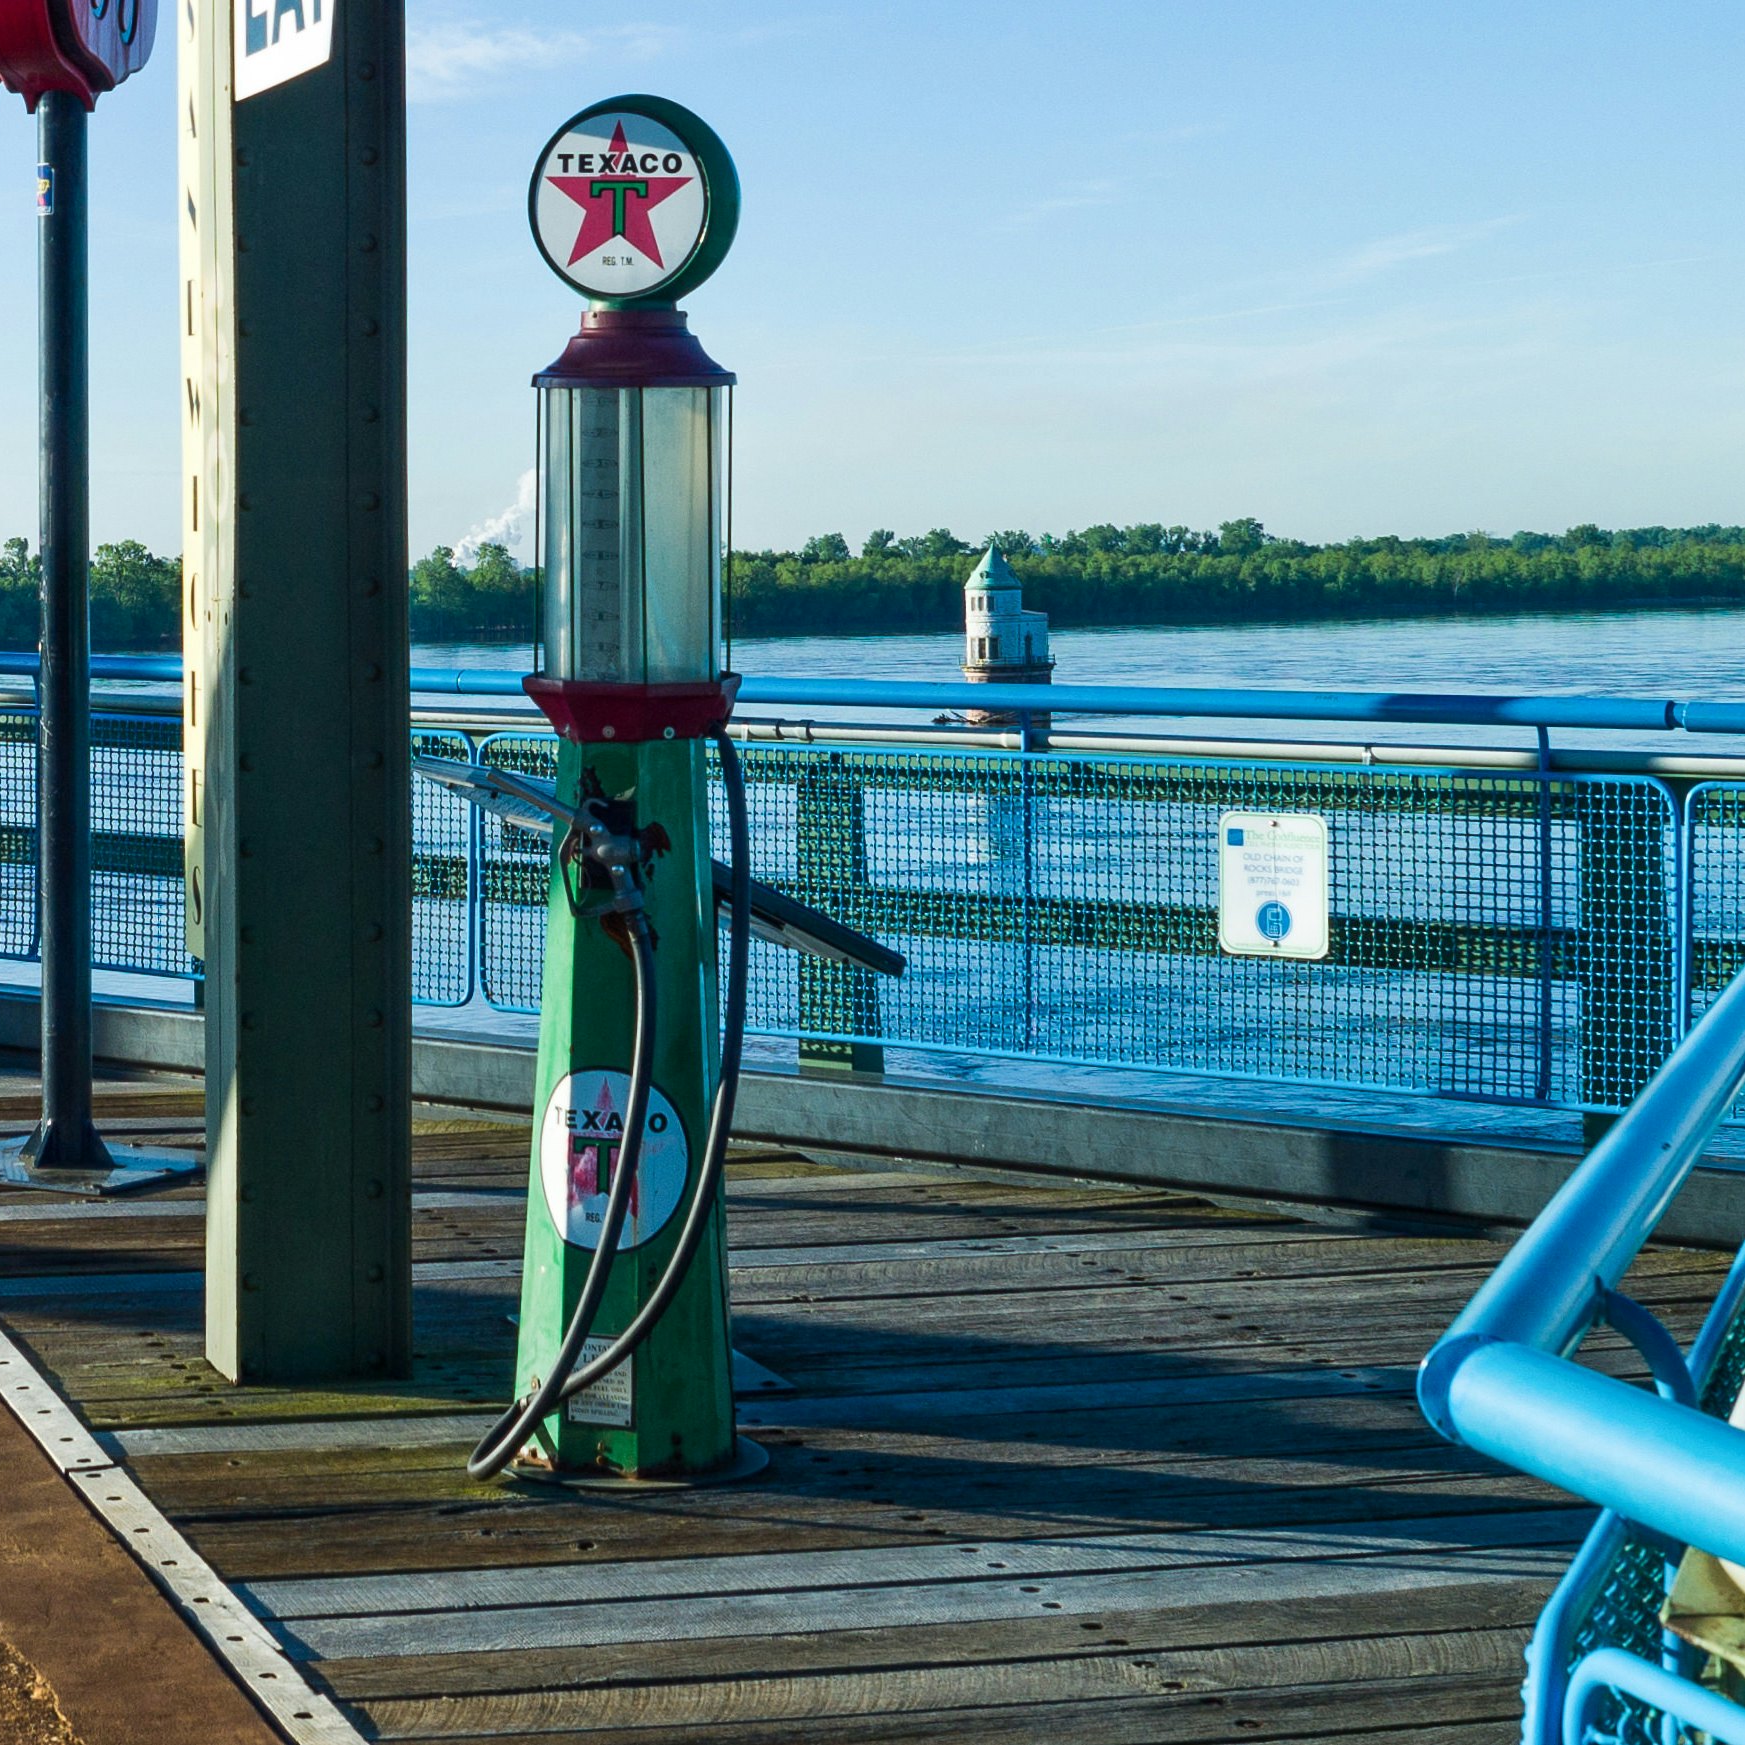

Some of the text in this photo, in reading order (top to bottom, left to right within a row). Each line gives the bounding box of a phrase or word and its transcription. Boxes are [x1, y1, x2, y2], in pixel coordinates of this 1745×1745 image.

[557, 152, 683, 174] TEXACO
[590, 180, 648, 238] T
[602, 256, 634, 266] REG. T.M.
[1243, 853, 1304, 863] OLD CHAIN OF
[1243, 864, 1303, 874] ROCKS BRIDGE
[555, 1106, 668, 1133] TEXAO
[573, 1136, 623, 1195] T
[585, 1212, 602, 1223] REG.
